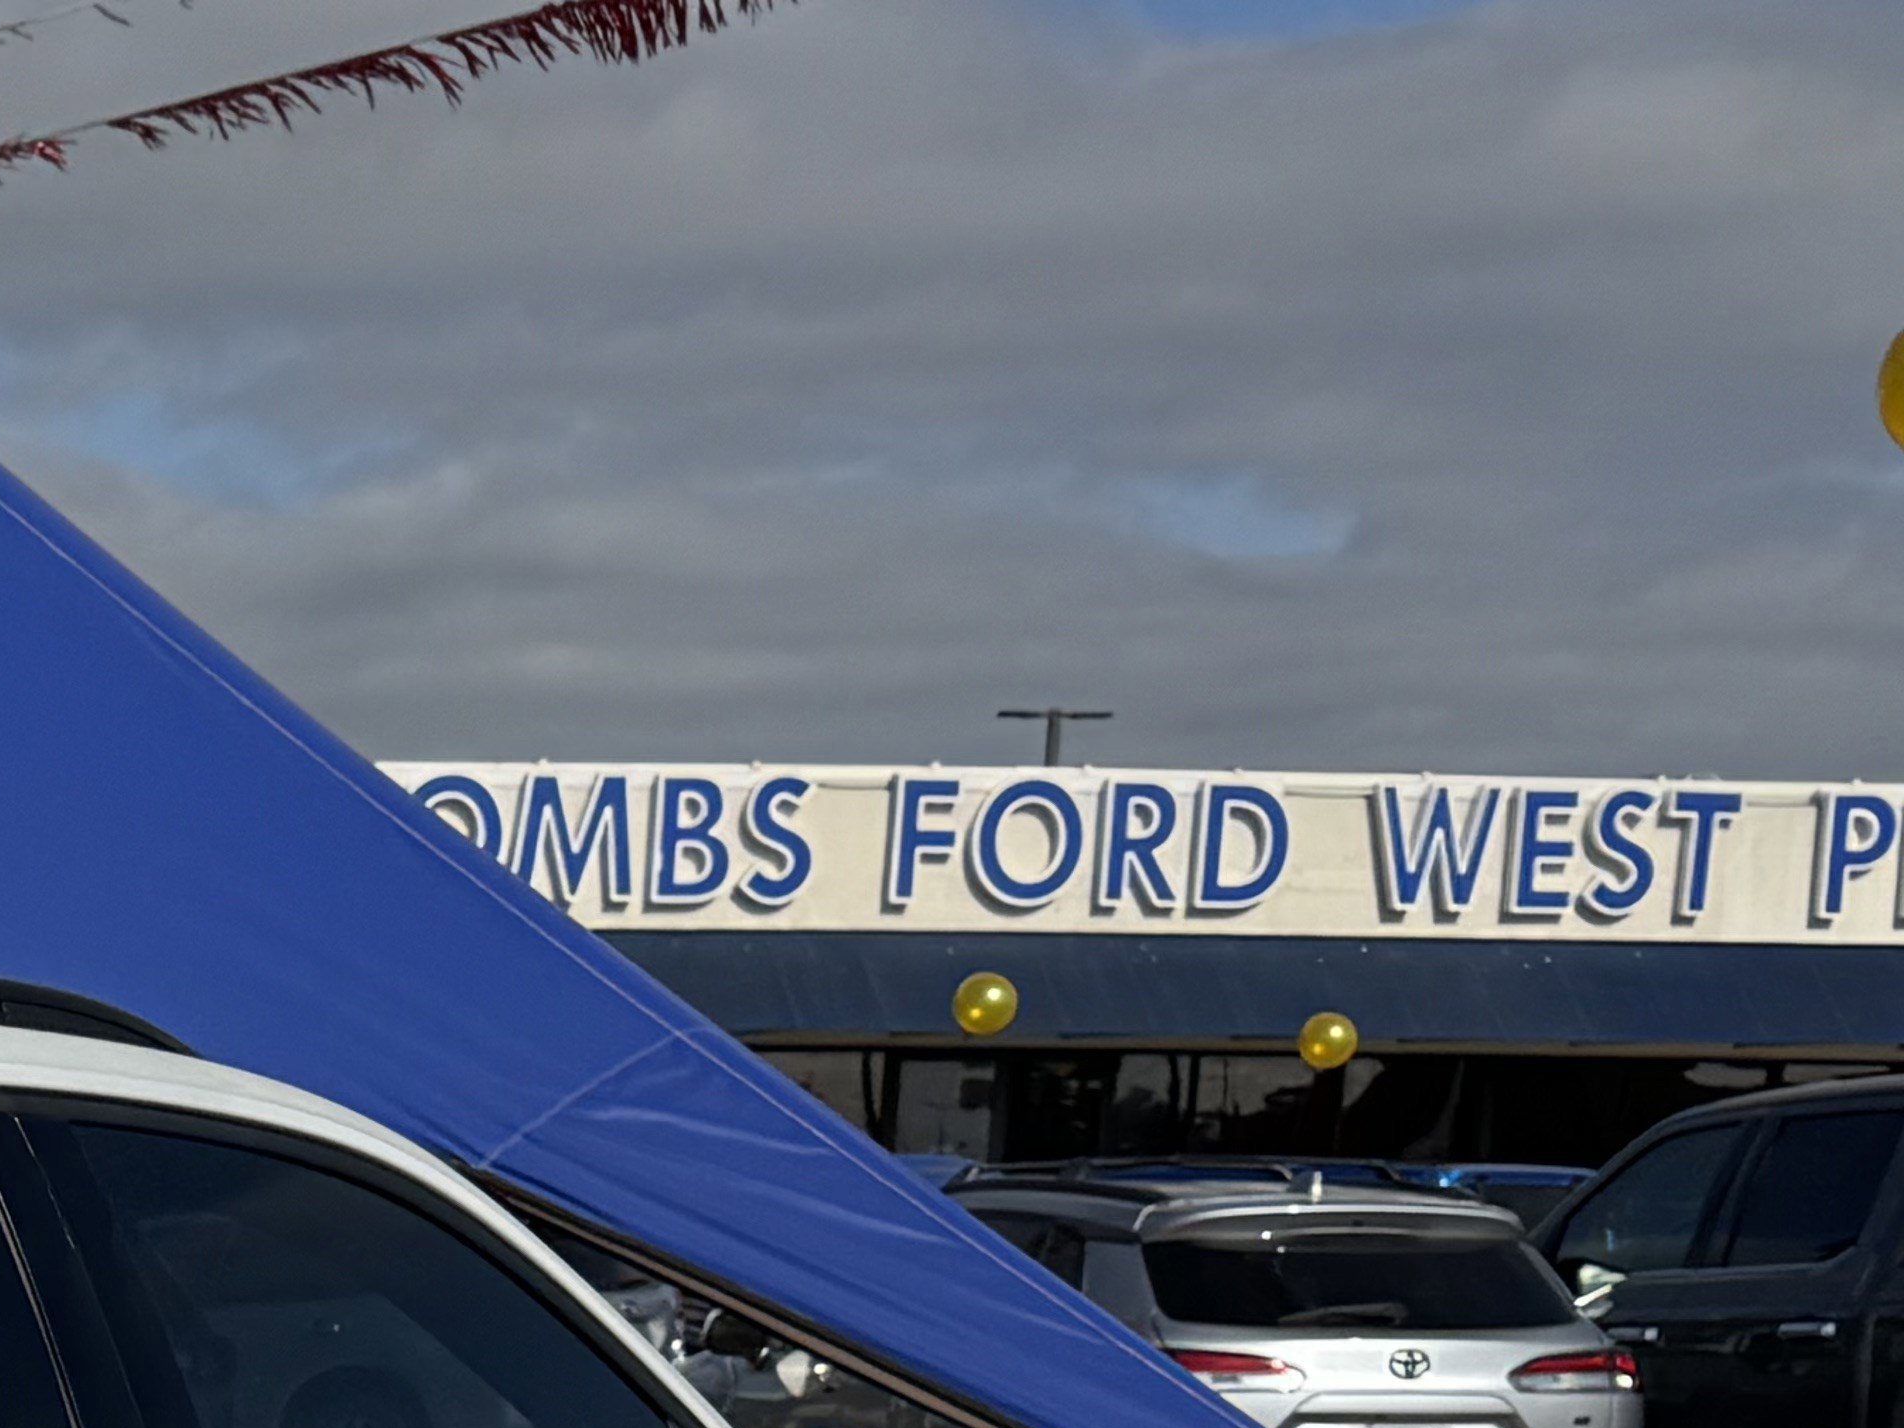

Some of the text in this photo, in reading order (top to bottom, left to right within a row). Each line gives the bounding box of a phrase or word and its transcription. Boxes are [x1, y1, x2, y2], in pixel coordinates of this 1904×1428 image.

[890, 779, 1289, 908] FORD
[1379, 786, 1742, 914] WEST
[1822, 795, 1904, 918] P
